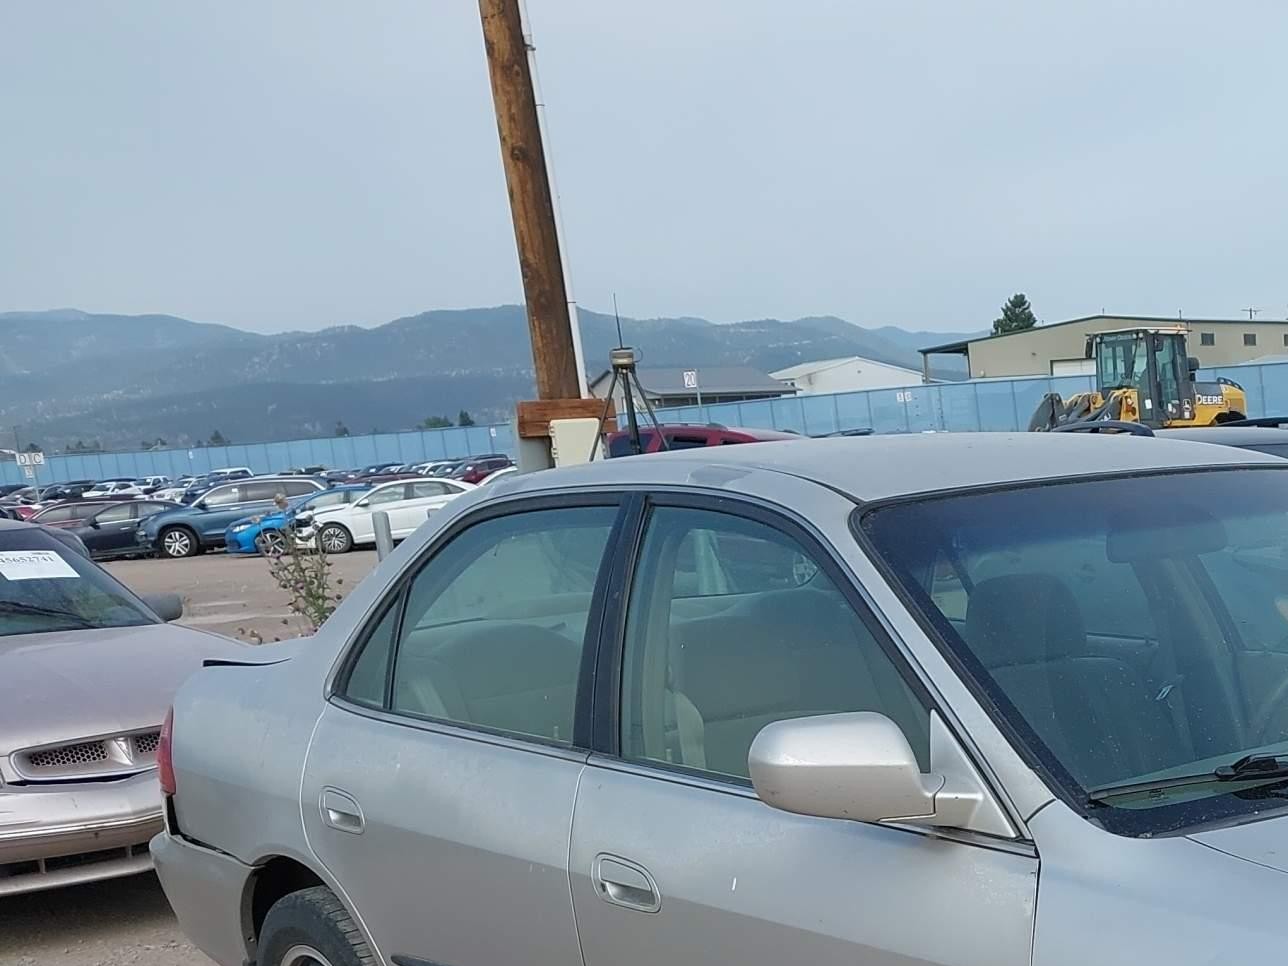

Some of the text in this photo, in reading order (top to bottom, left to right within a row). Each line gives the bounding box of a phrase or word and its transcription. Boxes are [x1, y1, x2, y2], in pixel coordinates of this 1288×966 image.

[685, 372, 696, 387] 20
[1195, 394, 1224, 405] DEERE
[18, 453, 42, 464] D C
